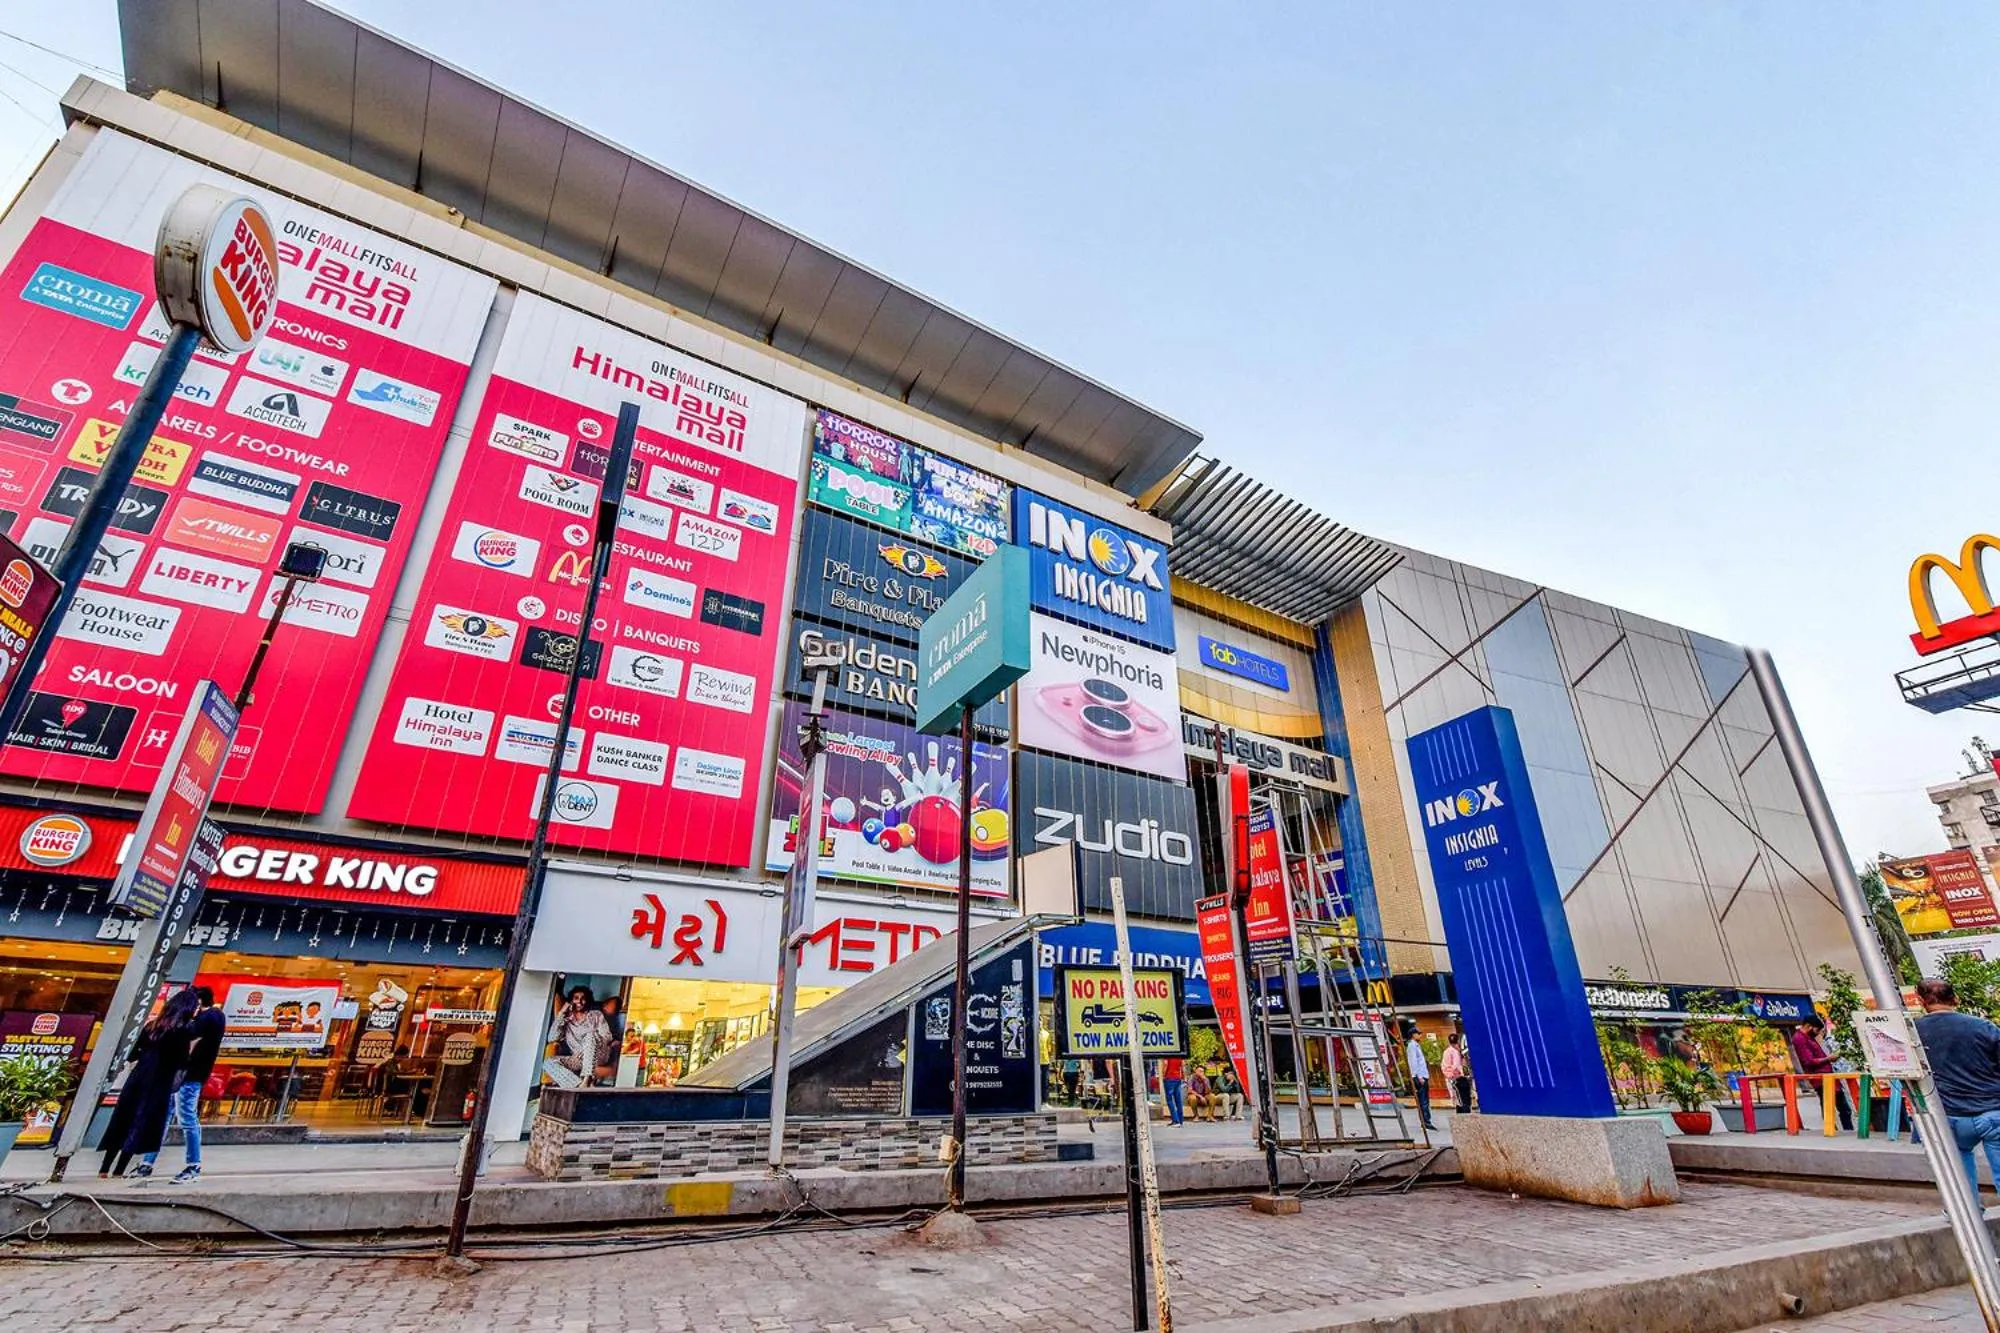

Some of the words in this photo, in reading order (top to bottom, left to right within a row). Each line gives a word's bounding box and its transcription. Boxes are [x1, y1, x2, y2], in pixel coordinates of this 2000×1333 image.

[234, 217, 276, 308] BURGER
[277, 241, 412, 304] alaya
[220, 239, 268, 331] KING
[304, 281, 405, 330] mall
[271, 317, 349, 351] TRONICS
[571, 346, 748, 432] Himalaya
[243, 405, 307, 432] ACCUTECH
[108, 398, 218, 440] AARELS
[236, 436, 350, 478] FOOTWEAR
[512, 423, 551, 441] SPARK
[675, 414, 744, 452] mall
[826, 415, 898, 455] HORROR
[579, 449, 638, 478] HORR
[632, 439, 722, 478] TERTAINMENT
[850, 440, 897, 465] HOUSE
[202, 465, 235, 482] BLUE
[237, 476, 289, 498] BUDDHA
[827, 466, 900, 511] POOL
[317, 497, 396, 527] CITRUS
[524, 487, 555, 504] POOL
[557, 499, 590, 515] ROOM
[844, 496, 880, 516] TABLE
[205, 519, 272, 545] TWILLS
[681, 519, 738, 543] AMAZON
[924, 503, 1000, 538] AMAZON
[478, 538, 518, 551] BURGER
[478, 546, 517, 557] KING
[613, 542, 693, 573] ESTAURANT
[1029, 502, 1164, 592] INOX
[1, 576, 26, 600] KING
[153, 560, 251, 595] LIBERTY
[643, 586, 692, 607] Domino's
[883, 577, 904, 599] &
[907, 584, 946, 611] Fla
[1054, 562, 1148, 625] INSIGNIA
[67, 596, 170, 632] Footwear
[296, 594, 359, 621] METRO
[830, 588, 924, 630] Banquets
[79, 618, 144, 643] House
[555, 609, 608, 632] DISO
[624, 625, 701, 654] BANQUETS
[799, 629, 917, 681] Golden
[1088, 636, 1117, 651] iPhone
[1116, 644, 1126, 655] 15
[1042, 631, 1164, 691] Newphoria
[68, 665, 179, 699] SALOON
[694, 671, 753, 696] Rewind
[846, 671, 918, 714] BANQ
[425, 703, 475, 725] Hotel
[588, 704, 641, 728] OTHER
[405, 717, 483, 742] Himalaya
[430, 735, 453, 748] inn
[847, 732, 896, 751] Largest
[6, 731, 36, 744] HAIR
[39, 737, 67, 750] SKIN
[71, 742, 109, 755] BRIDAL
[596, 745, 623, 757] KUSH
[624, 748, 664, 764] BANKER
[826, 743, 868, 762] owling
[870, 750, 902, 767] Alley
[1181, 714, 1284, 770] imalaya
[1289, 751, 1338, 783] mall
[596, 755, 629, 768] DANCE
[631, 760, 660, 773] CLASS
[567, 793, 594, 805] MAX
[567, 800, 595, 814] DENT
[1424, 780, 1505, 828] INOX
[29, 836, 75, 852] KING
[33, 828, 80, 842] BURGER
[200, 820, 224, 849] HOTEL
[1444, 823, 1500, 857] INSIGNIA
[1250, 842, 1268, 858] otel
[323, 857, 438, 896] KING
[851, 860, 865, 869] Pool
[1944, 886, 1983, 900] INOX
[1252, 897, 1271, 917] Inn
[96, 917, 141, 942] BK
[796, 917, 944, 972] METR
[1071, 979, 1095, 999] NO
[1100, 979, 1169, 999] PAKING
[356, 1047, 392, 1058] KING
[976, 1041, 995, 1049] DISC
[1074, 1033, 1101, 1048] TOW
[1105, 1032, 1130, 1048] AWA
[1142, 1031, 1174, 1047] ZONE
[442, 1049, 475, 1060] KING
[965, 1065, 1000, 1075] NQUETS
